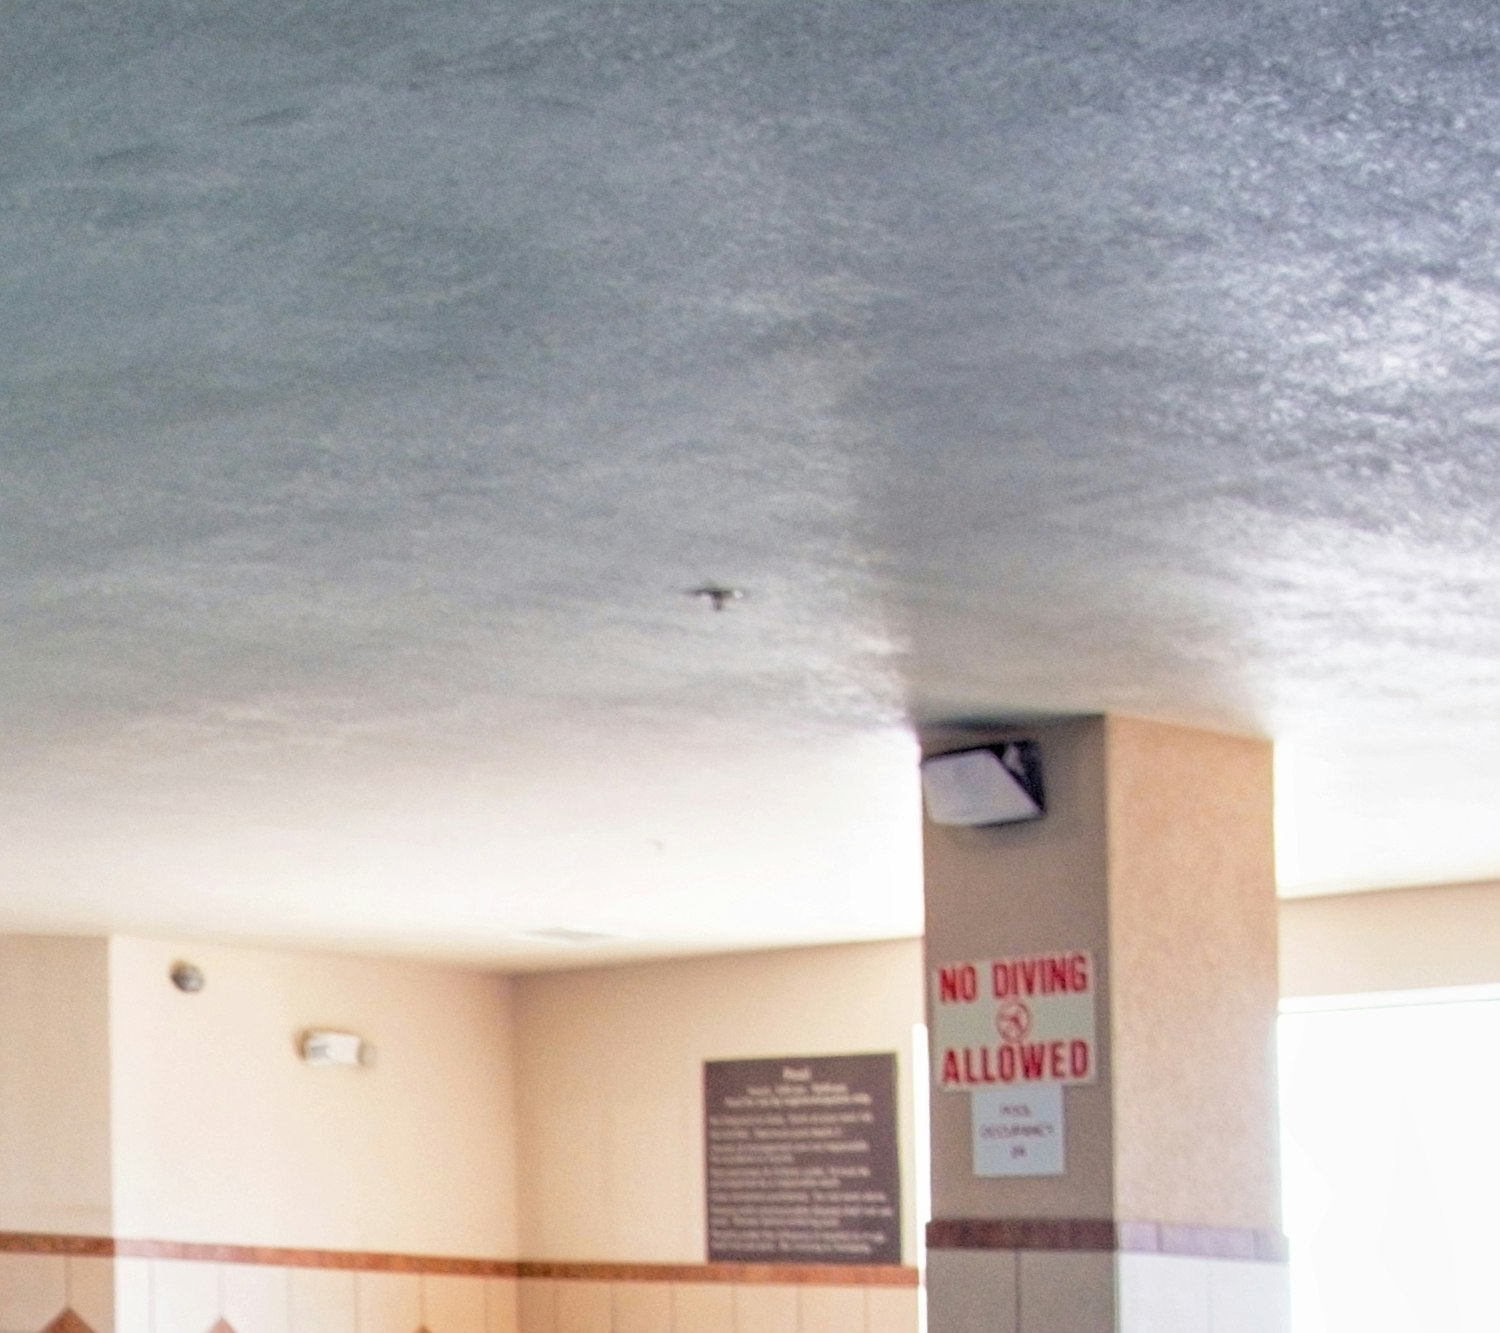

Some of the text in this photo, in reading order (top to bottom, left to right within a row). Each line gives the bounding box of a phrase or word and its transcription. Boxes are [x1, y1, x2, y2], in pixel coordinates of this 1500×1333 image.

[939, 954, 1088, 1003] NO DIVING
[943, 1040, 1088, 1083] ALLOWED
